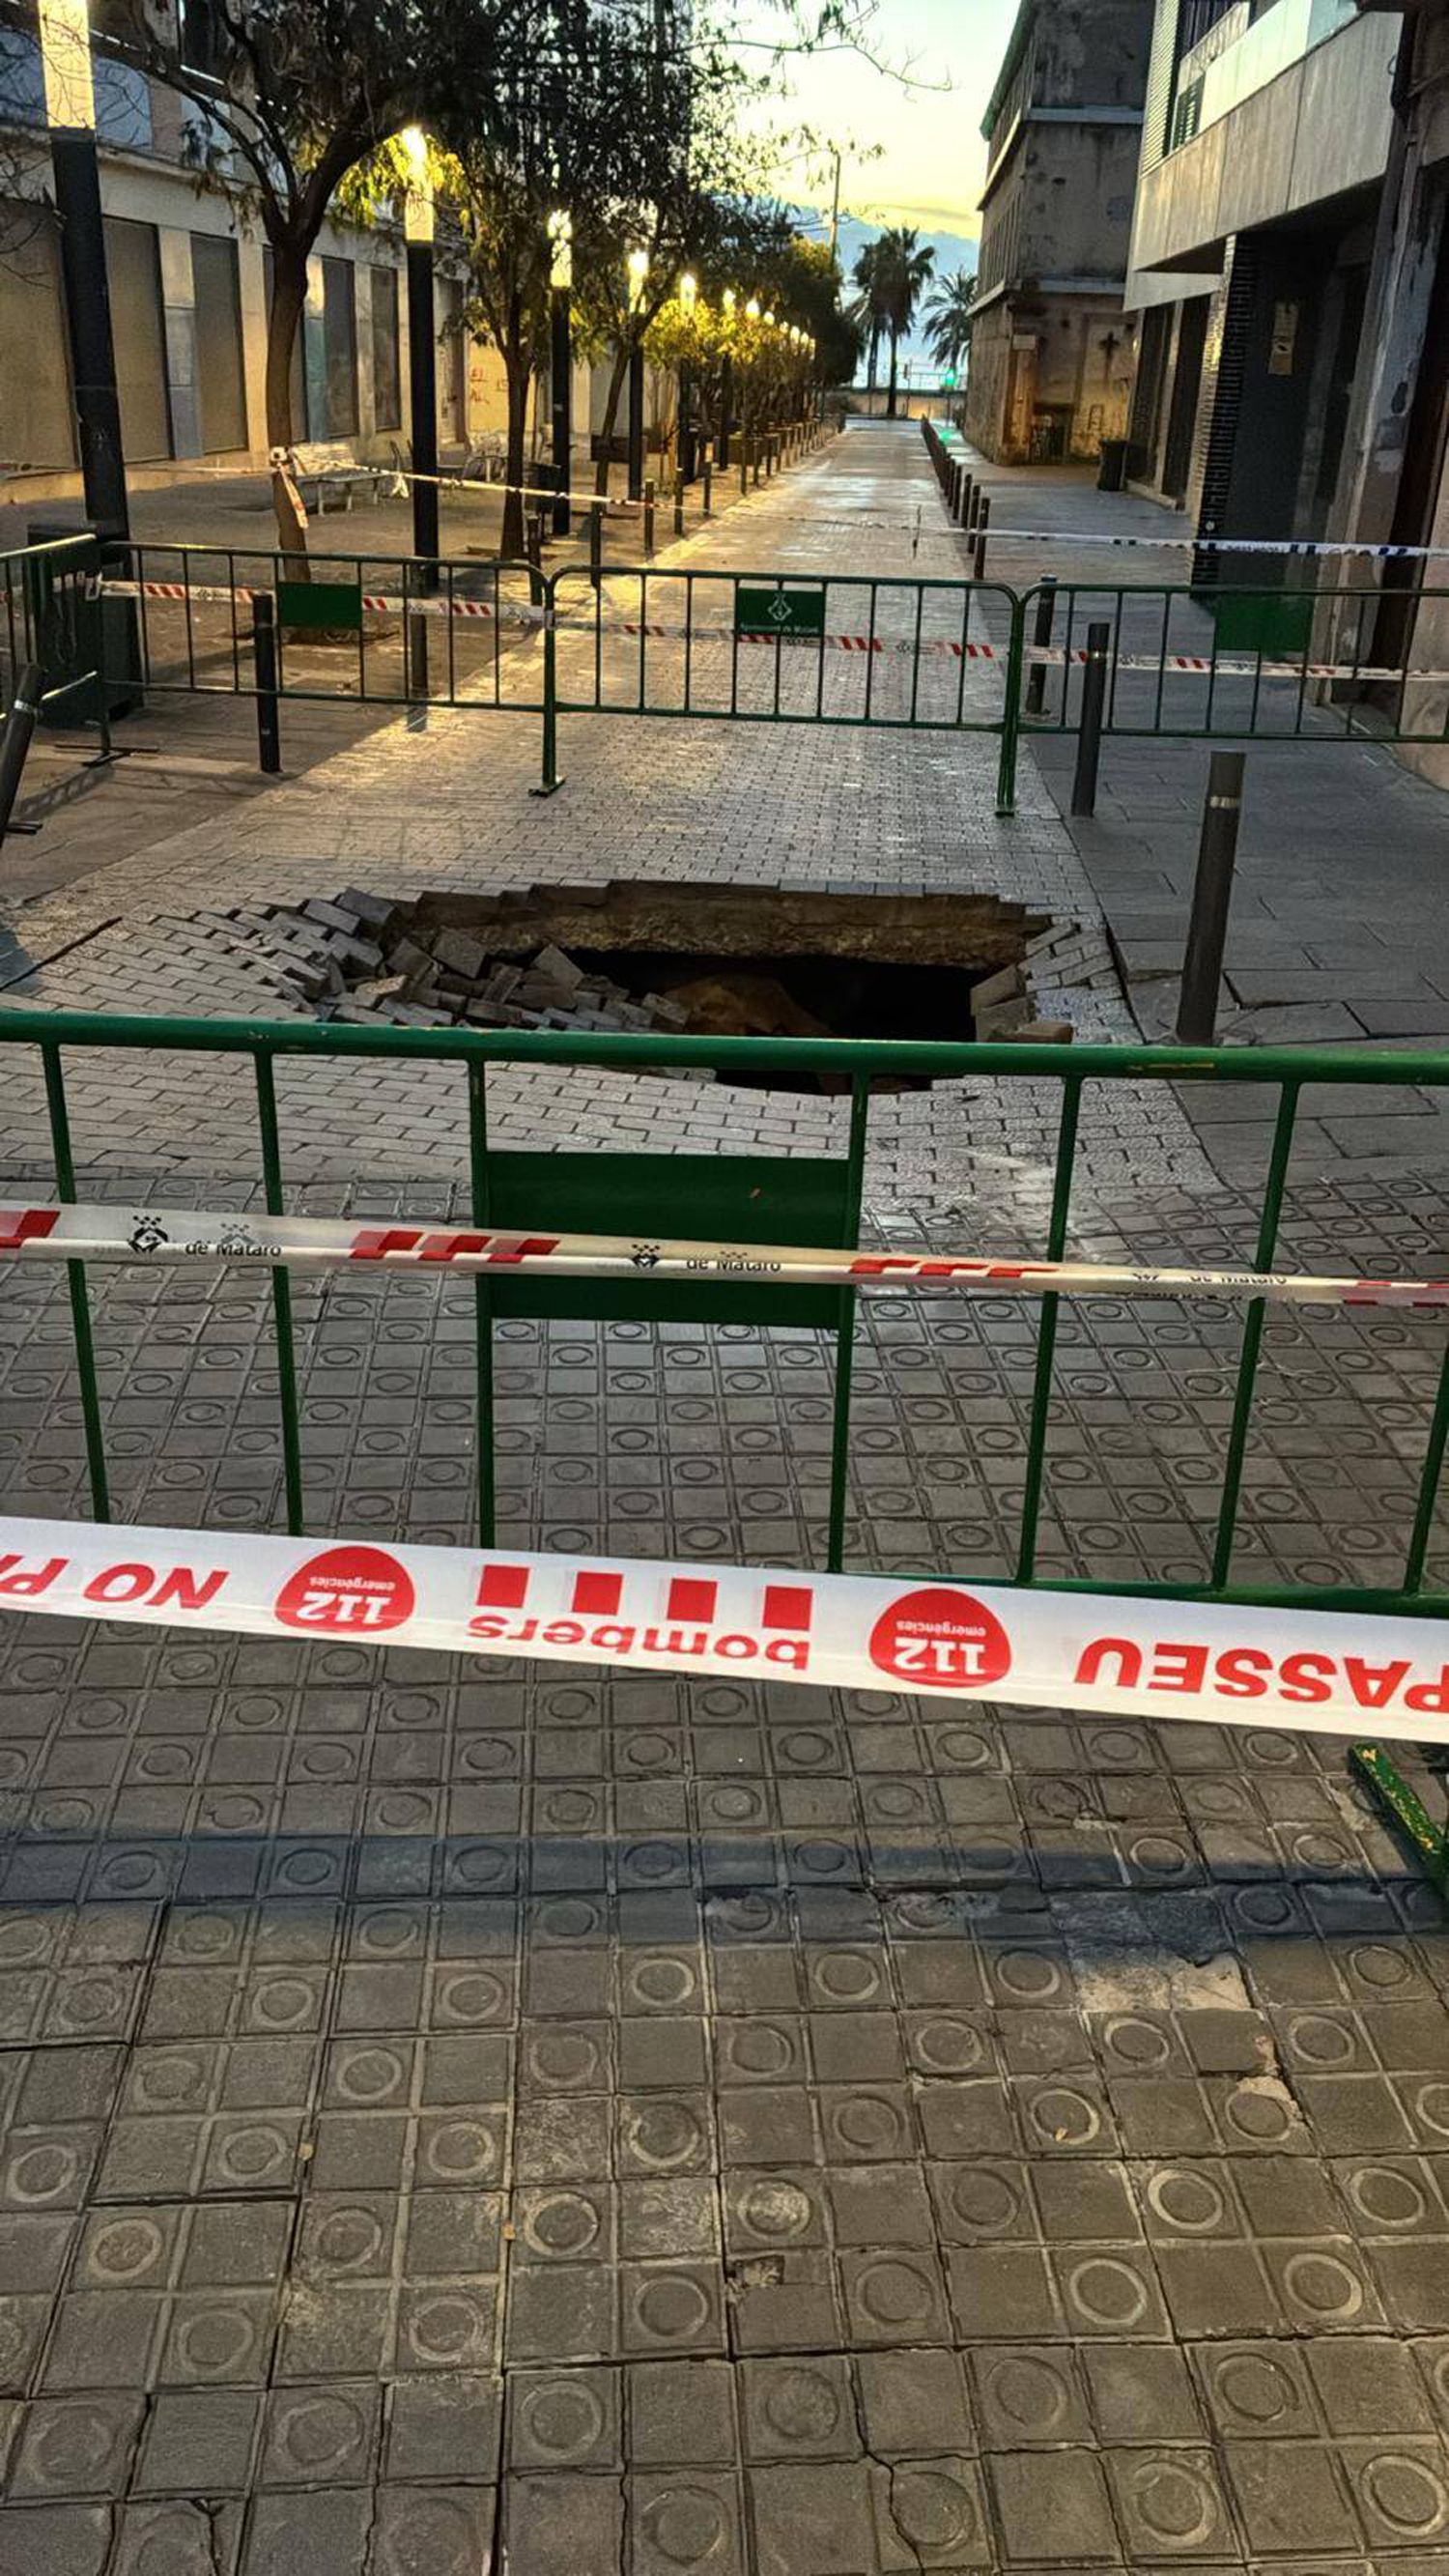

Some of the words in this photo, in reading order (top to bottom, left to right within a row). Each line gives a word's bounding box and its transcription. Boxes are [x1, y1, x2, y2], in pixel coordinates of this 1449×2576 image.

[83, 1562, 229, 1609] NO
[295, 1590, 393, 1625] 112
[470, 1614, 810, 1672] bombers
[893, 1637, 987, 1675] 112
[1075, 1637, 1449, 1716] PASSEU
